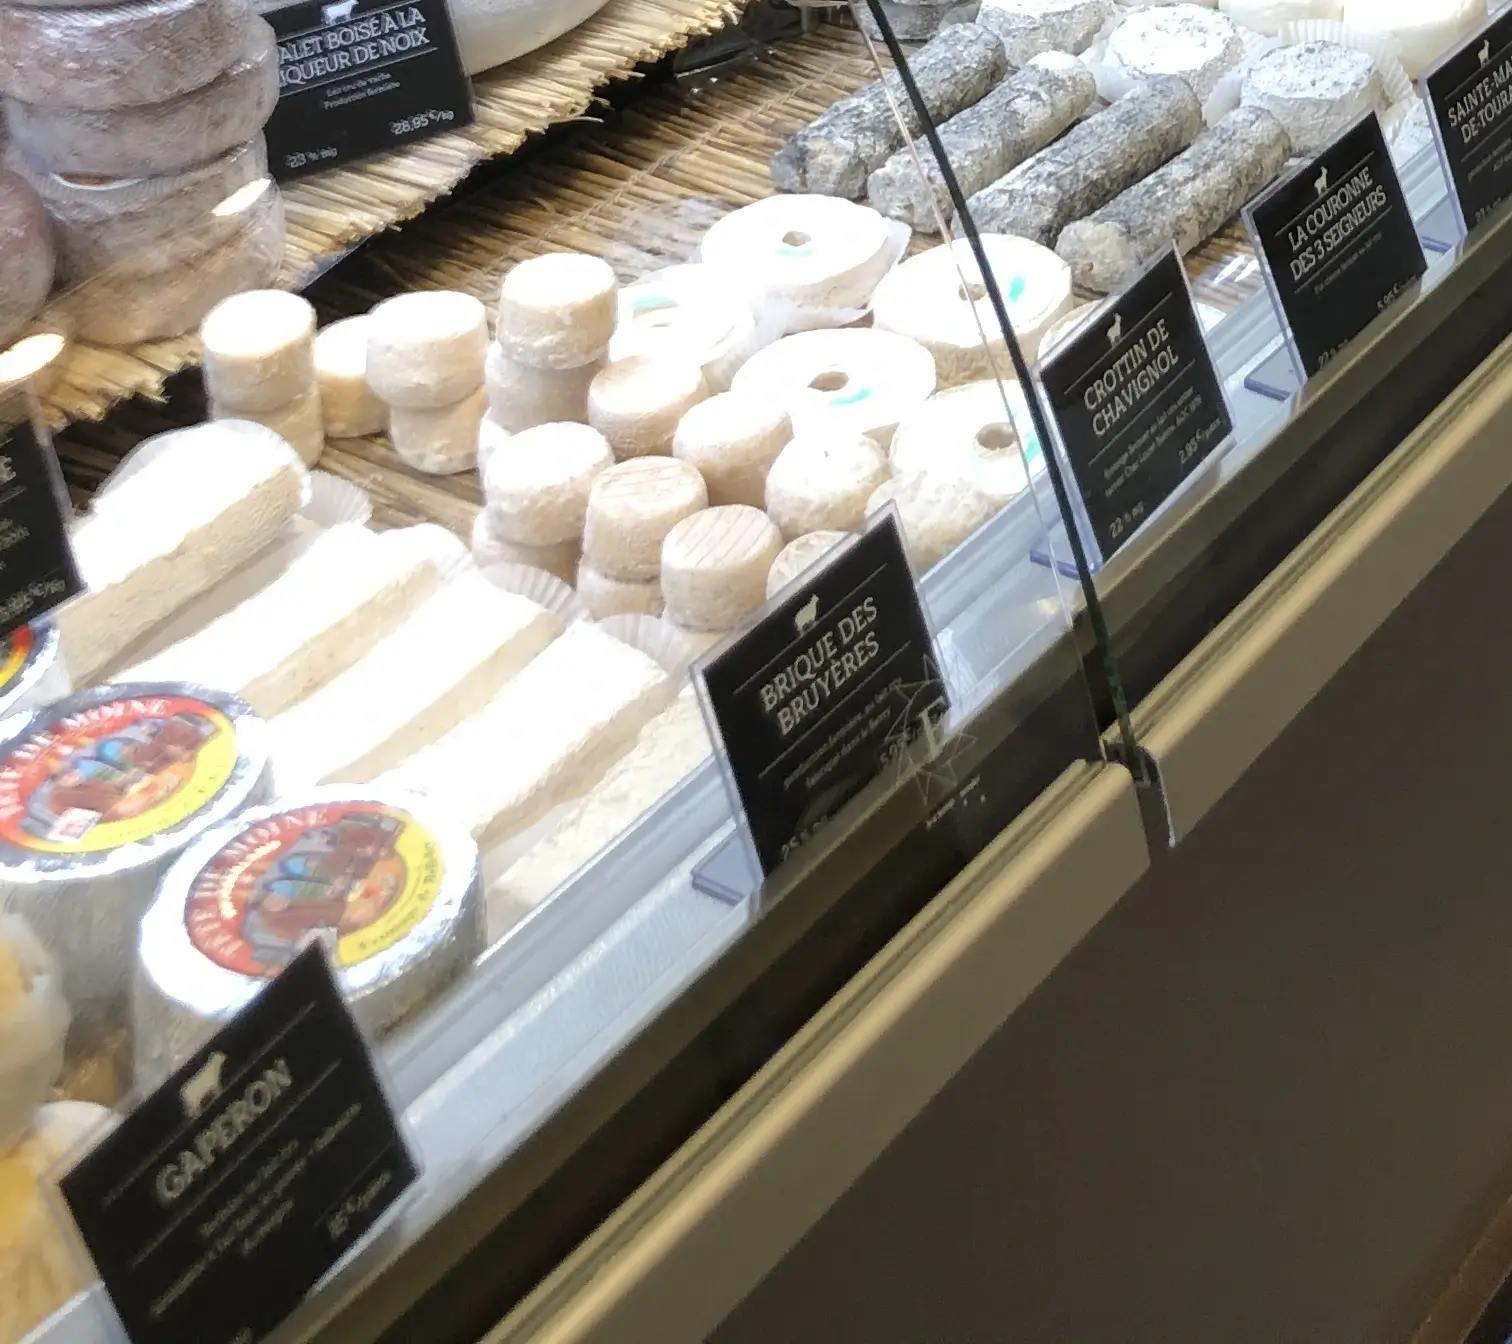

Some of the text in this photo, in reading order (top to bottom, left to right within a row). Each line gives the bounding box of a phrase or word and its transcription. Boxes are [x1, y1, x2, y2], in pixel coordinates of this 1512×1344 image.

[278, 35, 322, 64] ALET
[382, 9, 398, 32] À
[397, 4, 425, 28] LA
[278, 26, 430, 90] IQUEUR DE NOIX
[1288, 165, 1372, 251] LA COURONNE
[1290, 245, 1316, 281] DES
[1322, 183, 1386, 252] SEIGNEURS
[1082, 317, 1169, 414] CROTTIN DE
[1090, 340, 1178, 440] CHAVIGNOL
[760, 594, 877, 716] BRIQUE DES
[775, 623, 880, 735] BRUYÈRES
[154, 1057, 293, 1203] GAPERON
